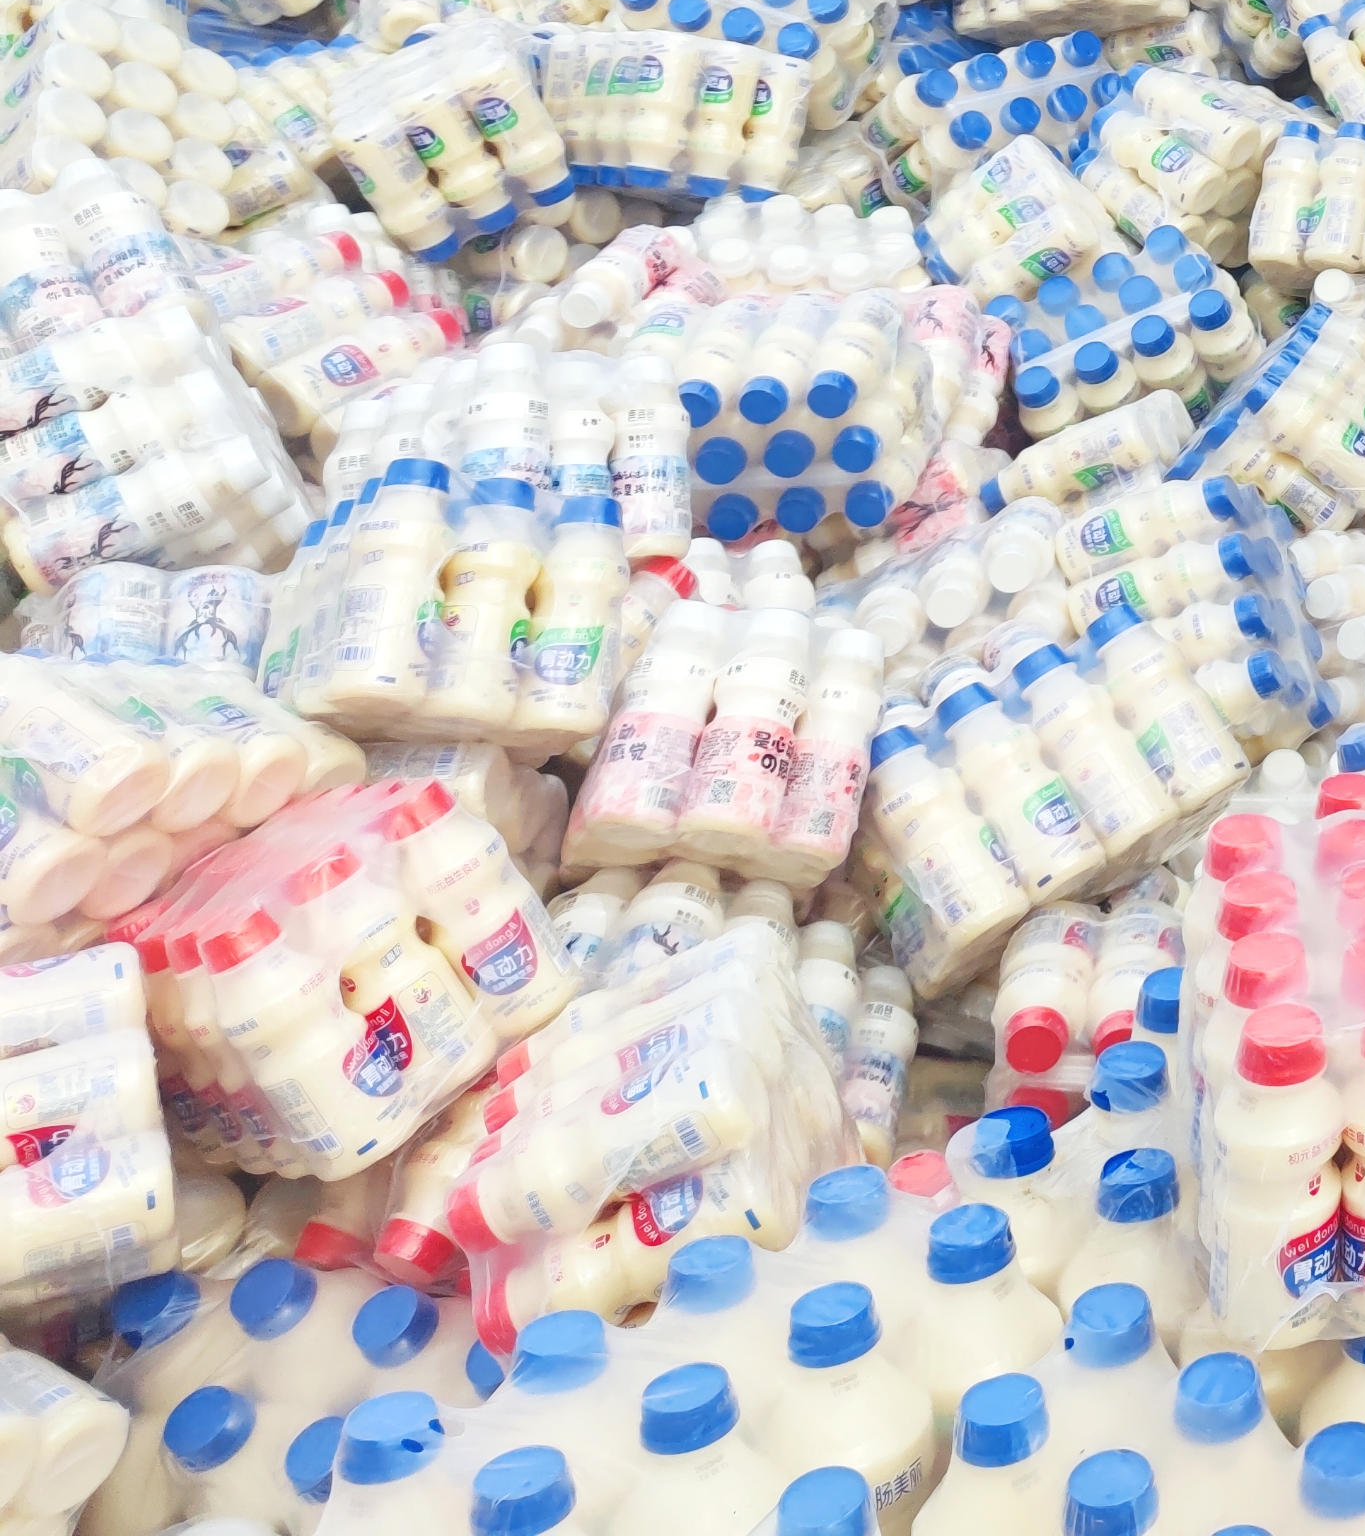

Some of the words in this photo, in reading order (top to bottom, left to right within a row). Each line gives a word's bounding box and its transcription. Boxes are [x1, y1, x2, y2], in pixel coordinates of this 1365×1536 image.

[541, 648, 593, 674] 胃动力
[480, 943, 535, 984] 胃动力
[1284, 1237, 1311, 1259] wei
[1313, 1216, 1339, 1244] dong
